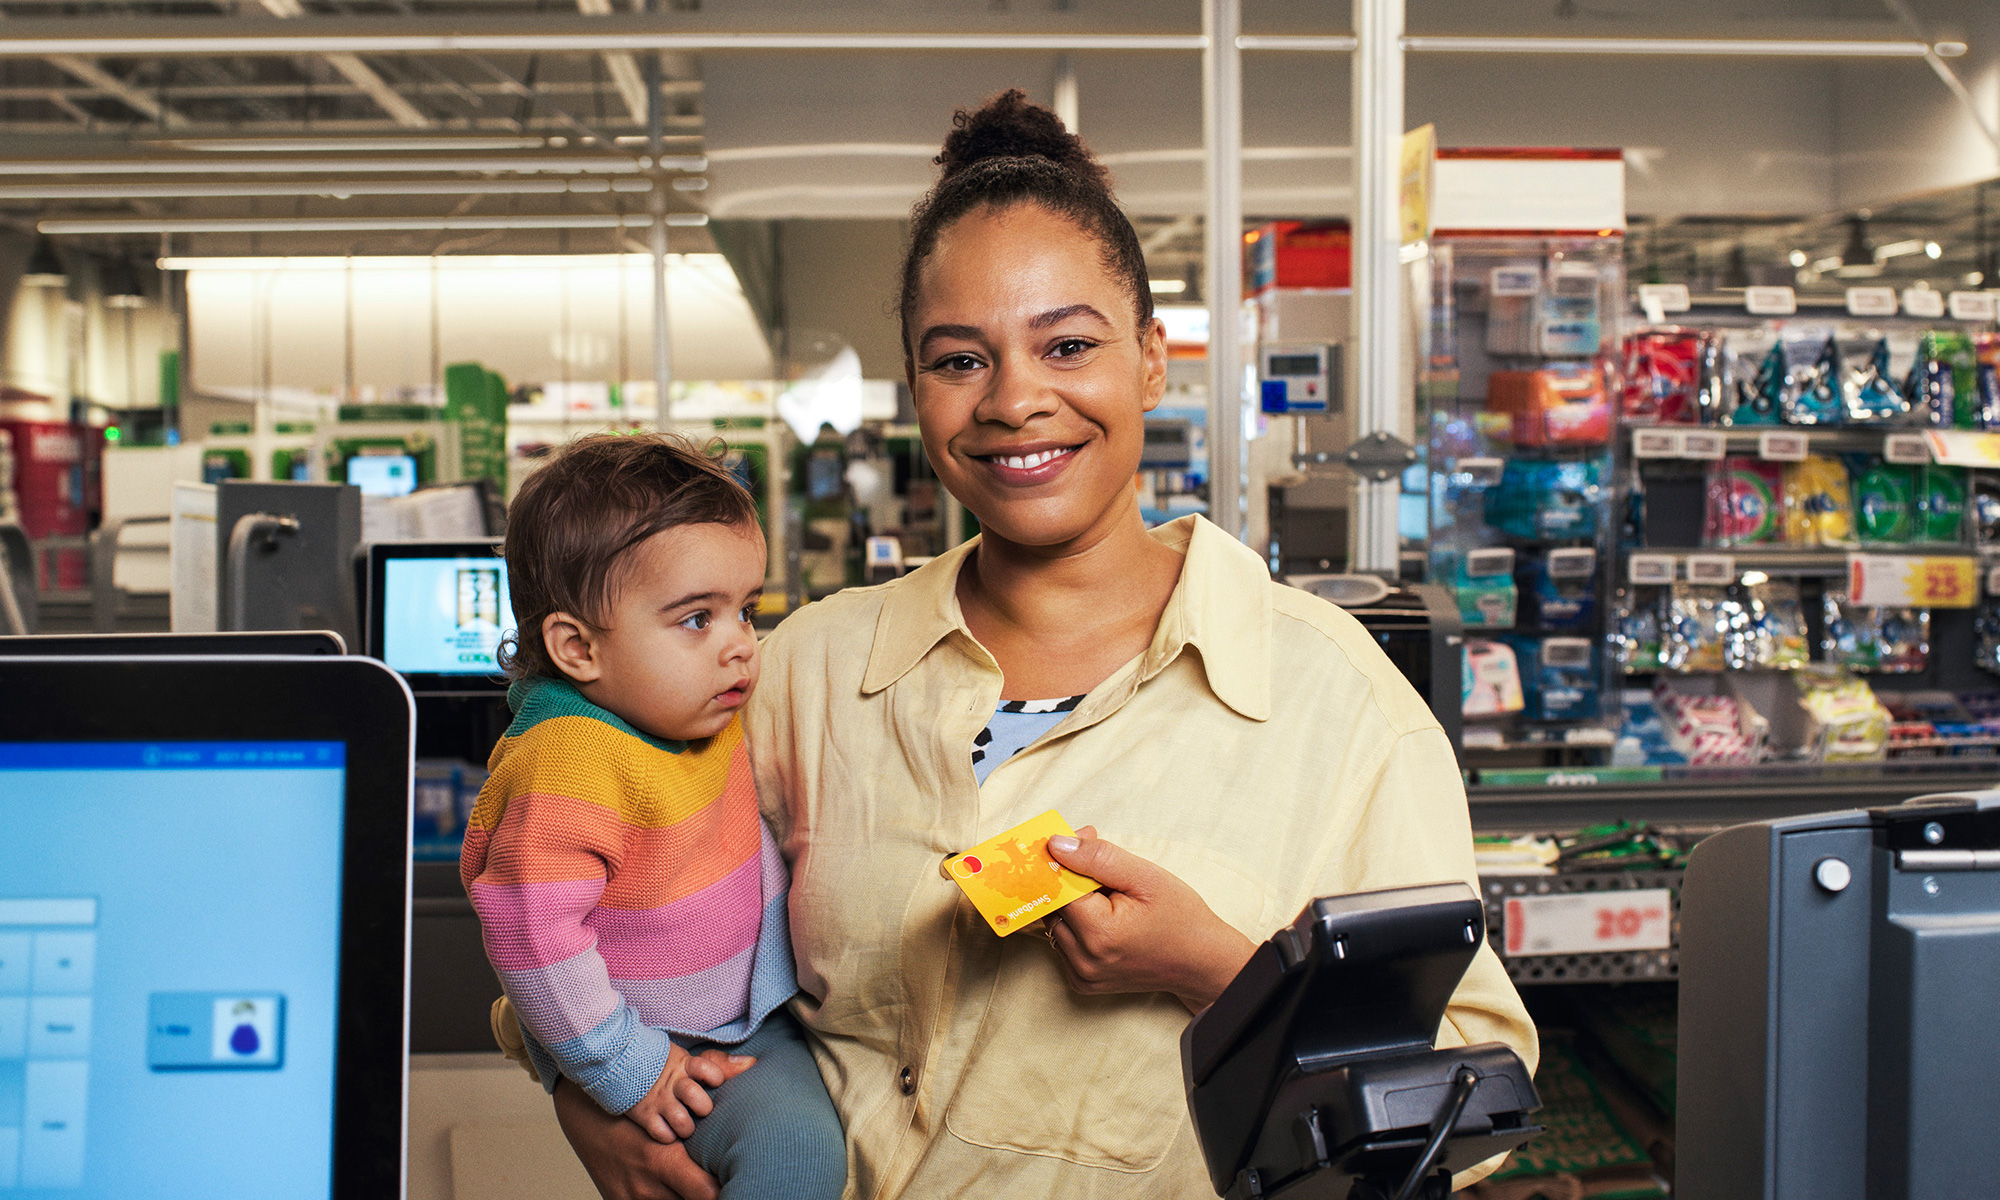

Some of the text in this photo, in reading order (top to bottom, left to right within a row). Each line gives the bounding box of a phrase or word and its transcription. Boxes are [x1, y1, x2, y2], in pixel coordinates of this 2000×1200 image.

[1925, 575, 1960, 599] 25
[1007, 894, 1052, 920] Swedbank
[1595, 907, 1641, 938] 20
